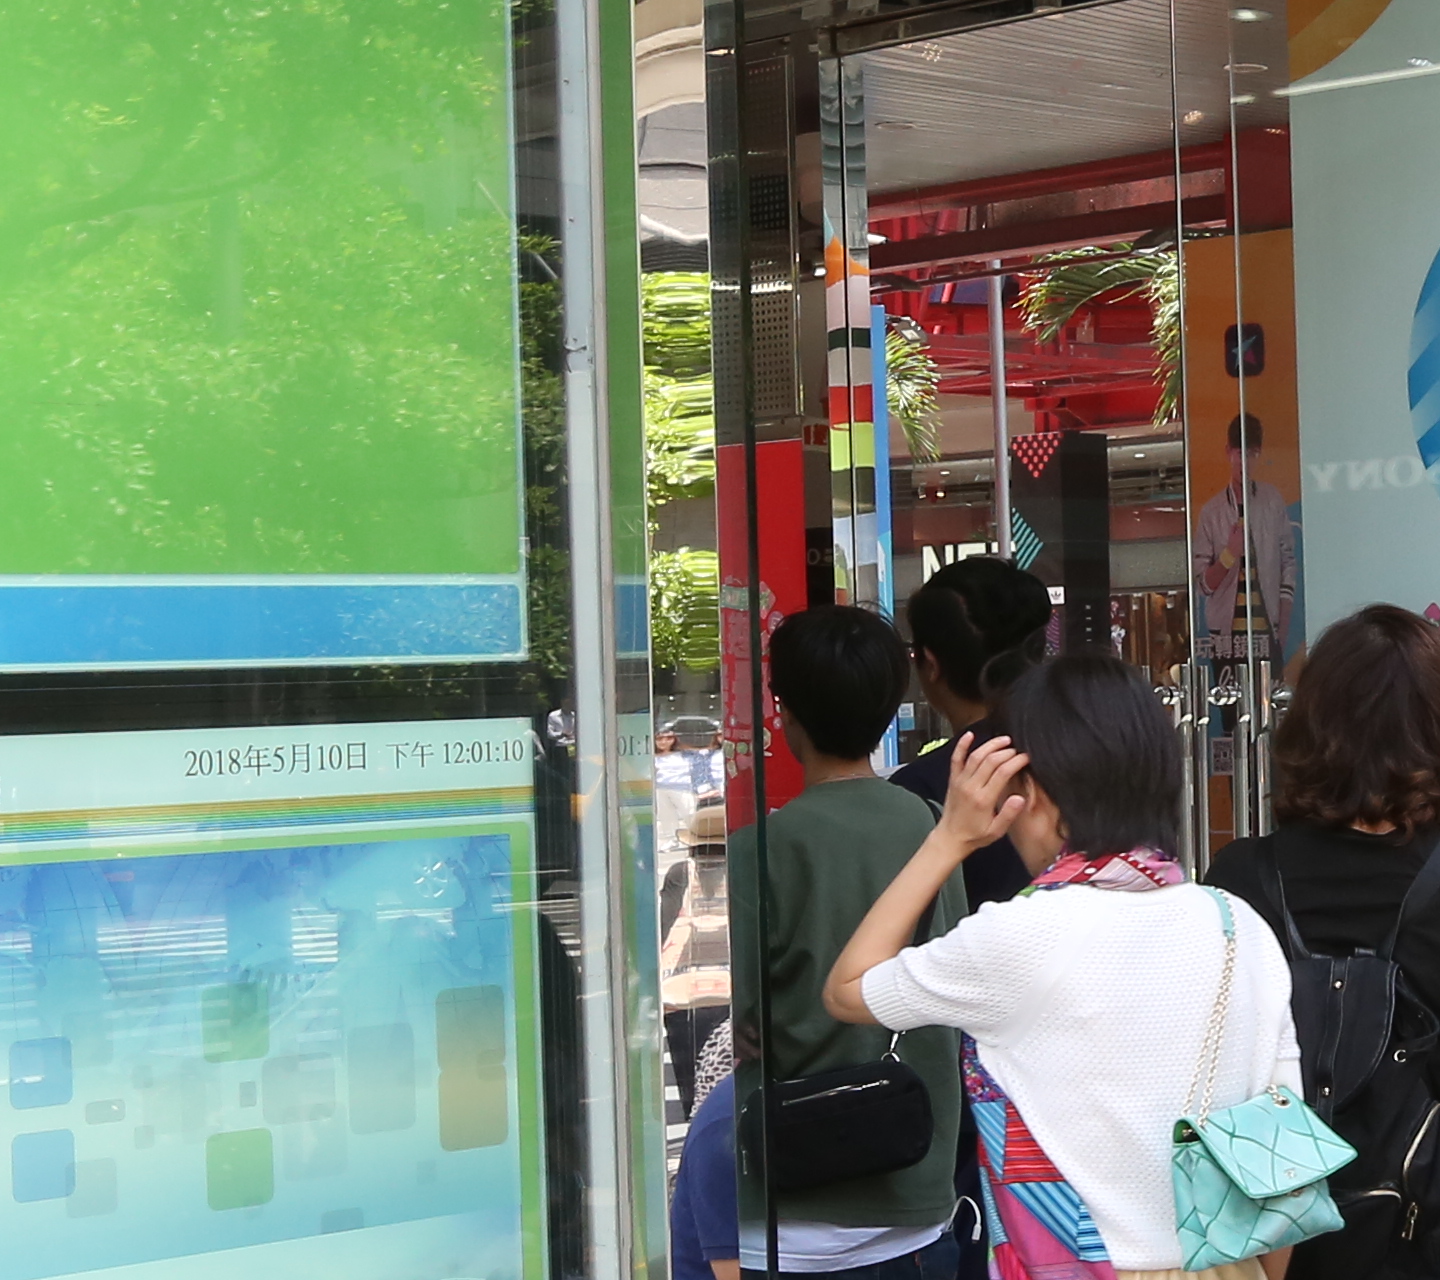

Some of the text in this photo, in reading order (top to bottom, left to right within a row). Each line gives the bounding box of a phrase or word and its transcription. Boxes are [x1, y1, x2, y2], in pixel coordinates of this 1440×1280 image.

[184, 738, 525, 779] 2018年5月10日 下午 12:01:10
